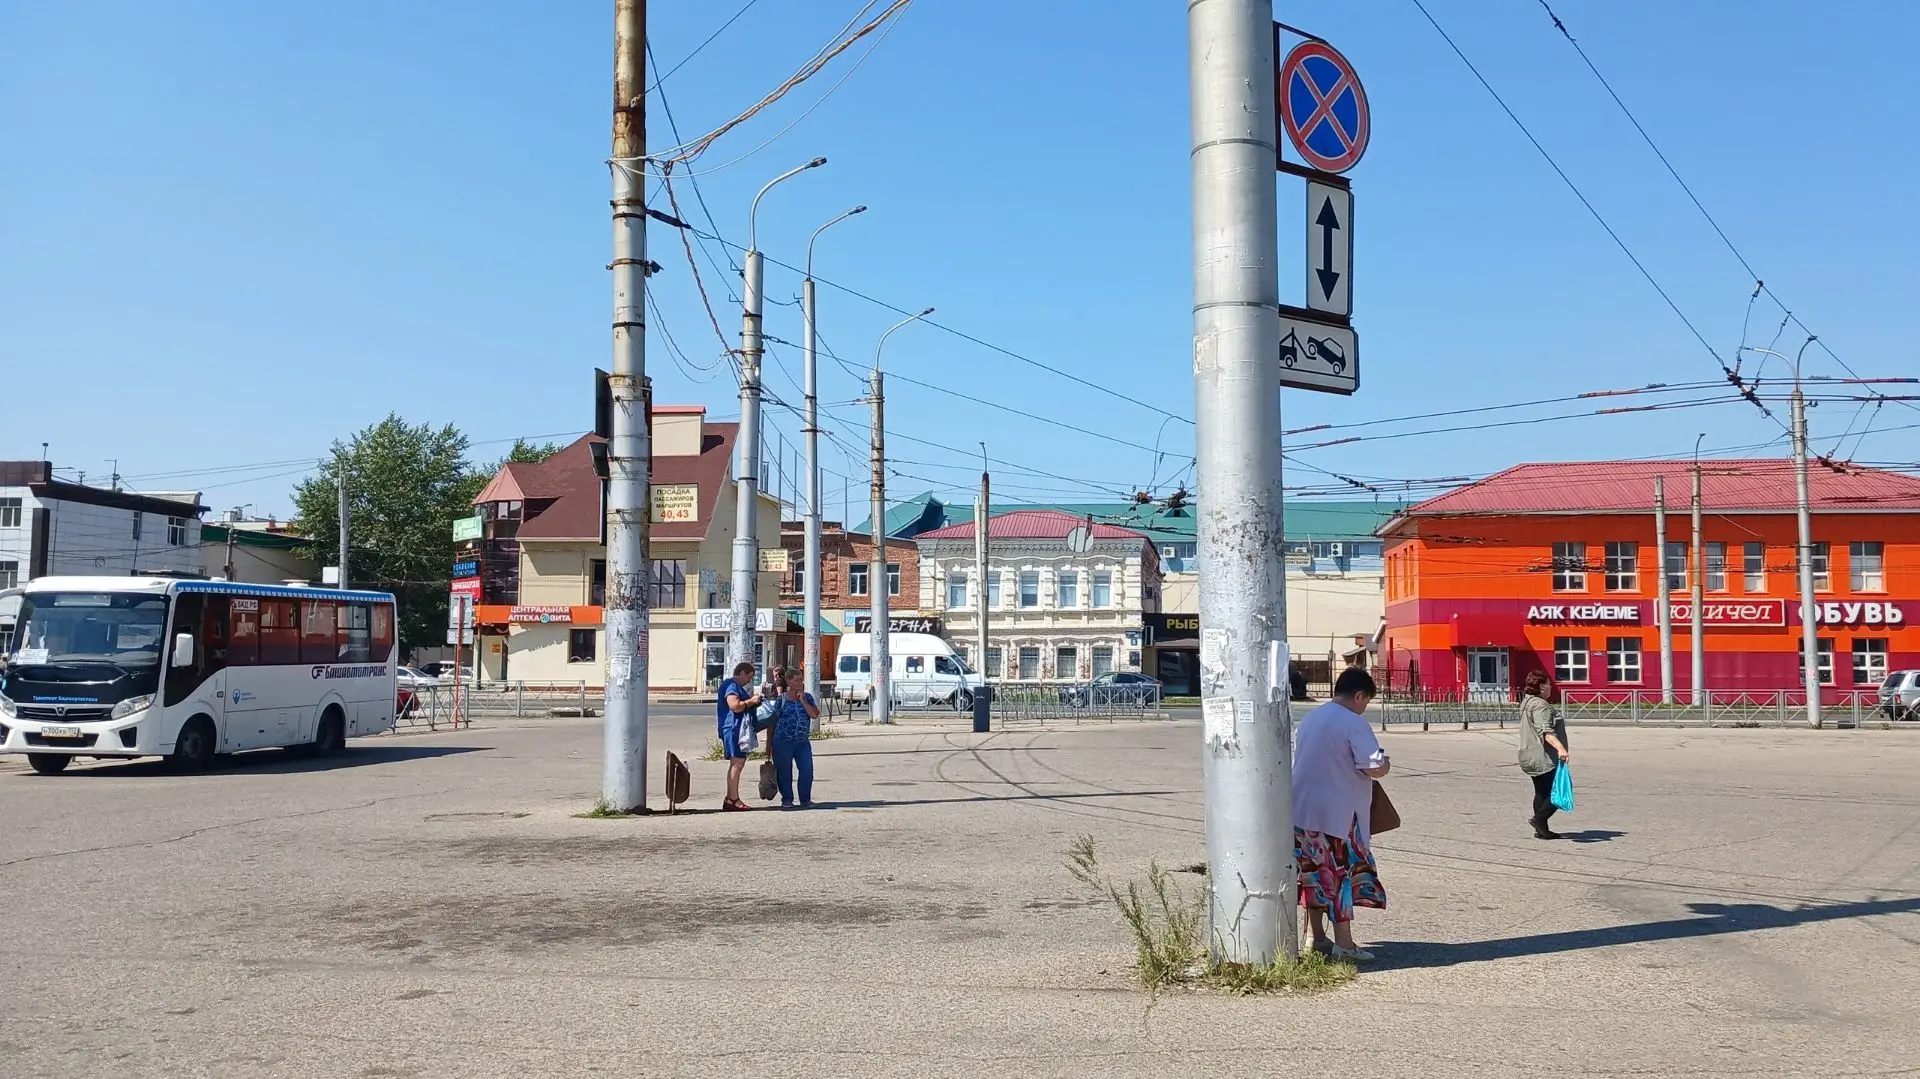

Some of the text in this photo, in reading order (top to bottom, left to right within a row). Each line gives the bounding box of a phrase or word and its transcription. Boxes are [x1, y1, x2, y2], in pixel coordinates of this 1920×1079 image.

[511, 606, 569, 614] ЦЕНТРАЛЬНАЯ
[1527, 602, 1640, 620] АЯК КЕЙЕМЕ
[508, 614, 571, 622] АПТЕКА ВИТА
[701, 612, 767, 629] СЕМА
[1166, 618, 1199, 630] РЫБ
[858, 619, 933, 633] ТЕРНА
